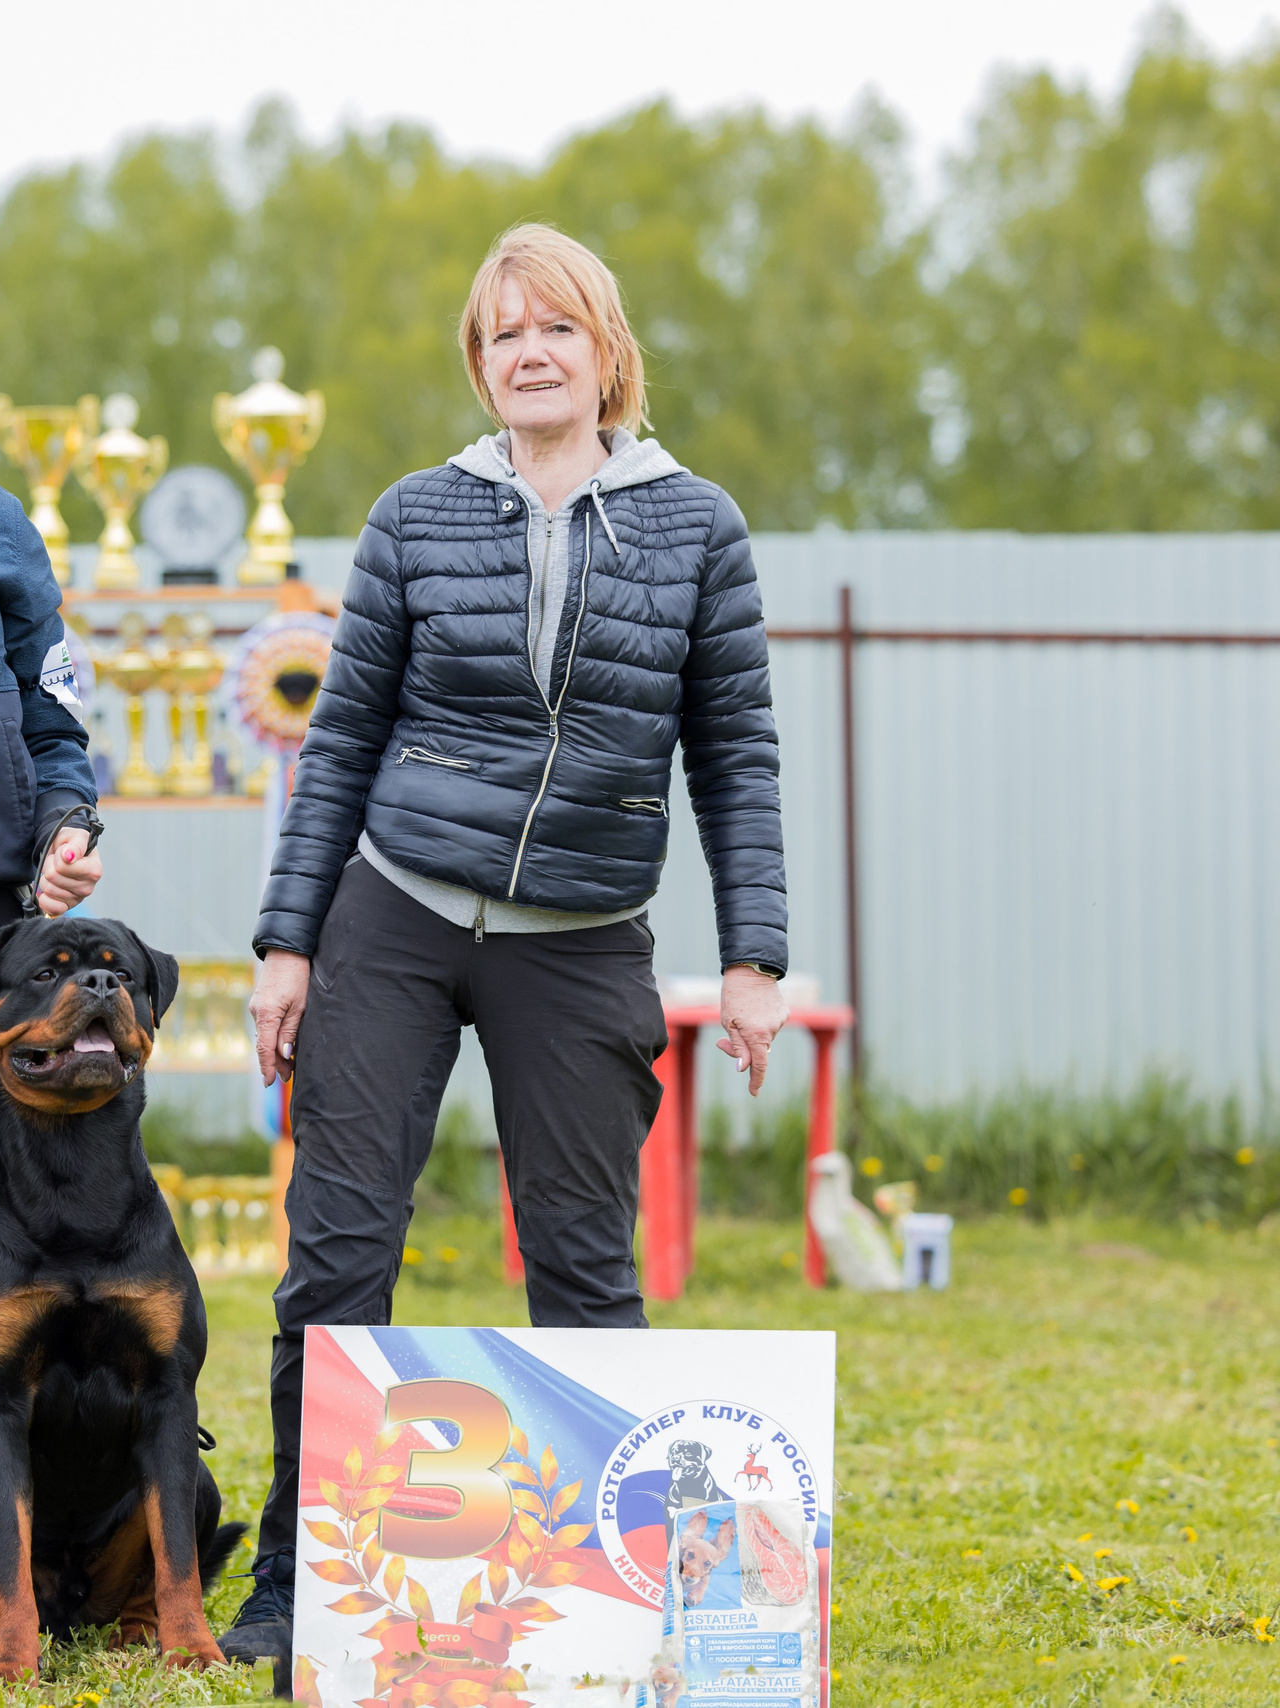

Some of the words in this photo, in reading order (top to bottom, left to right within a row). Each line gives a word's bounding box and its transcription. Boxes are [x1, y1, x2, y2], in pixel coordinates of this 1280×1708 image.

[378, 1377, 514, 1559] 3
[601, 1409, 686, 1520] РОТВЕЙЛЕР
[702, 1405, 763, 1430] КЛУБ
[771, 1431, 816, 1522] РОССИИ
[614, 1554, 664, 1604] НИЖЕ
[694, 1613, 758, 1625] STATERA
